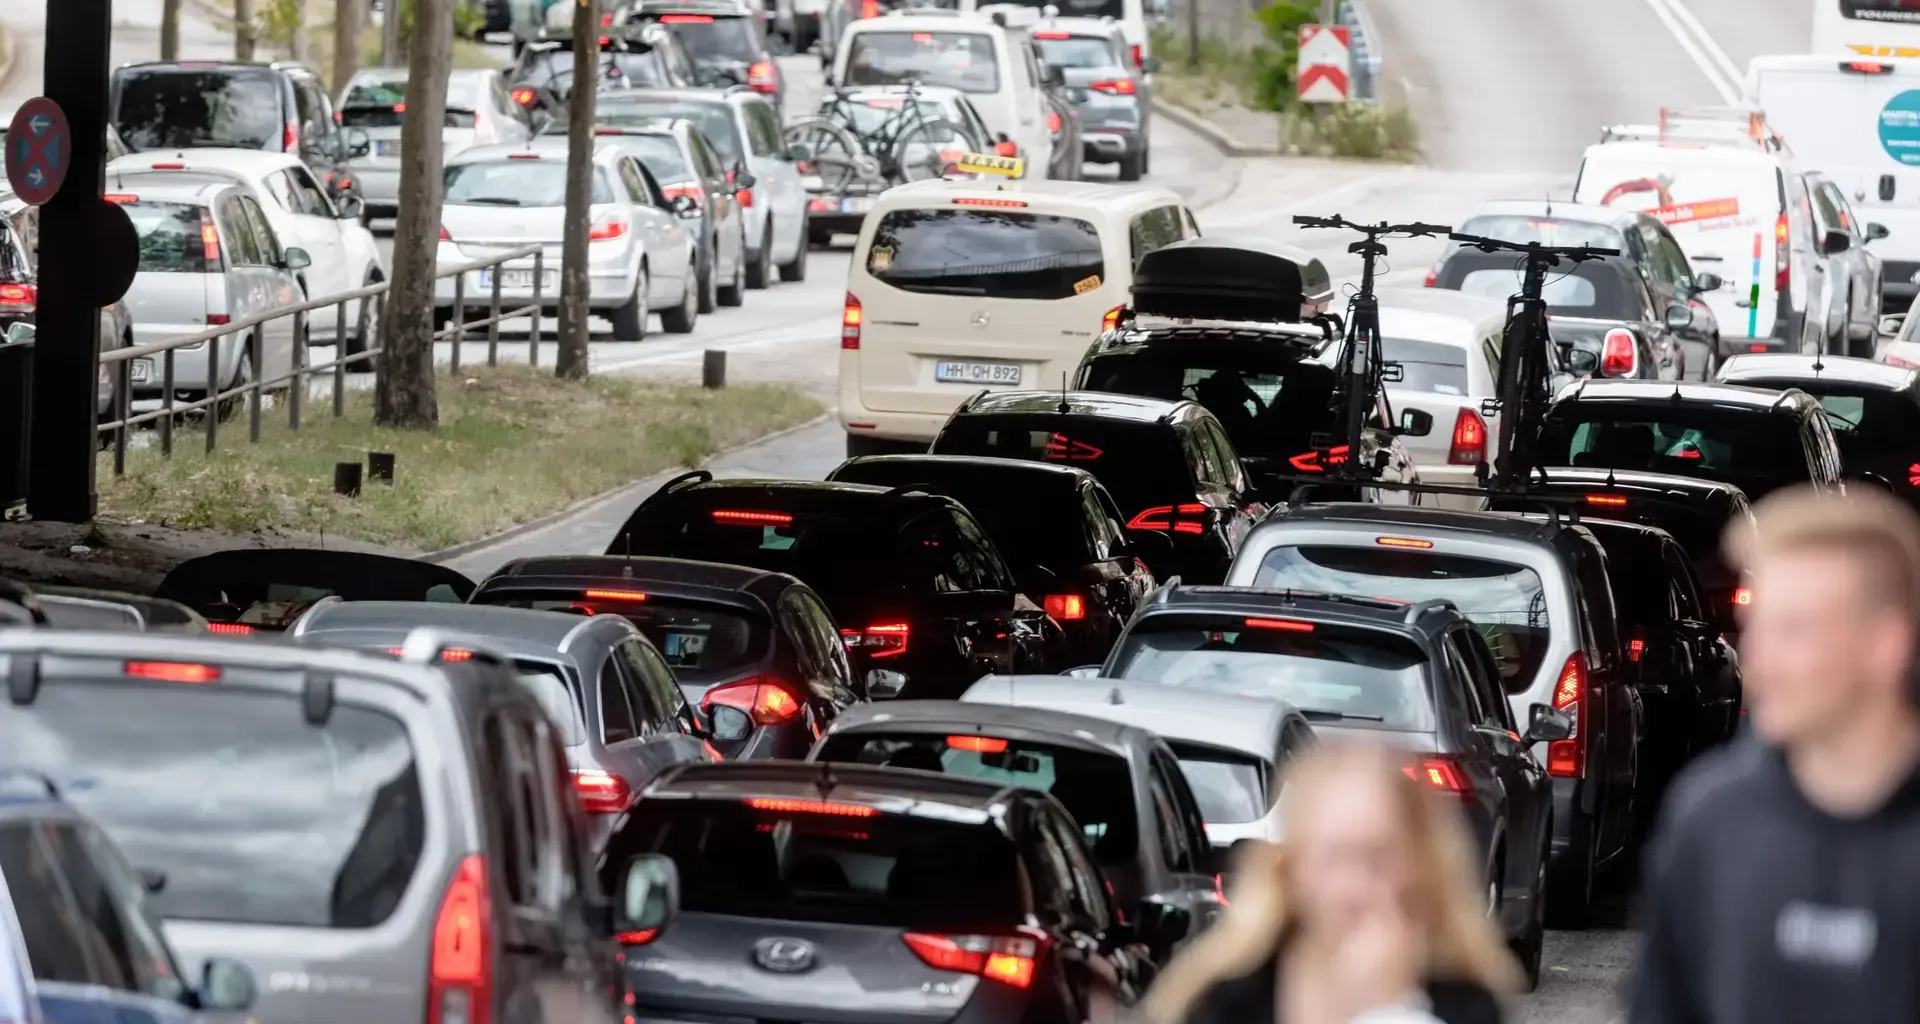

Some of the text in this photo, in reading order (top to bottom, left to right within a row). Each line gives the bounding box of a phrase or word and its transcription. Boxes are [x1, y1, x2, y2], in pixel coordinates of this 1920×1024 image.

[966, 154, 1010, 170] TAXI
[946, 363, 1019, 380] HH QH 892
[678, 636, 690, 656] K
